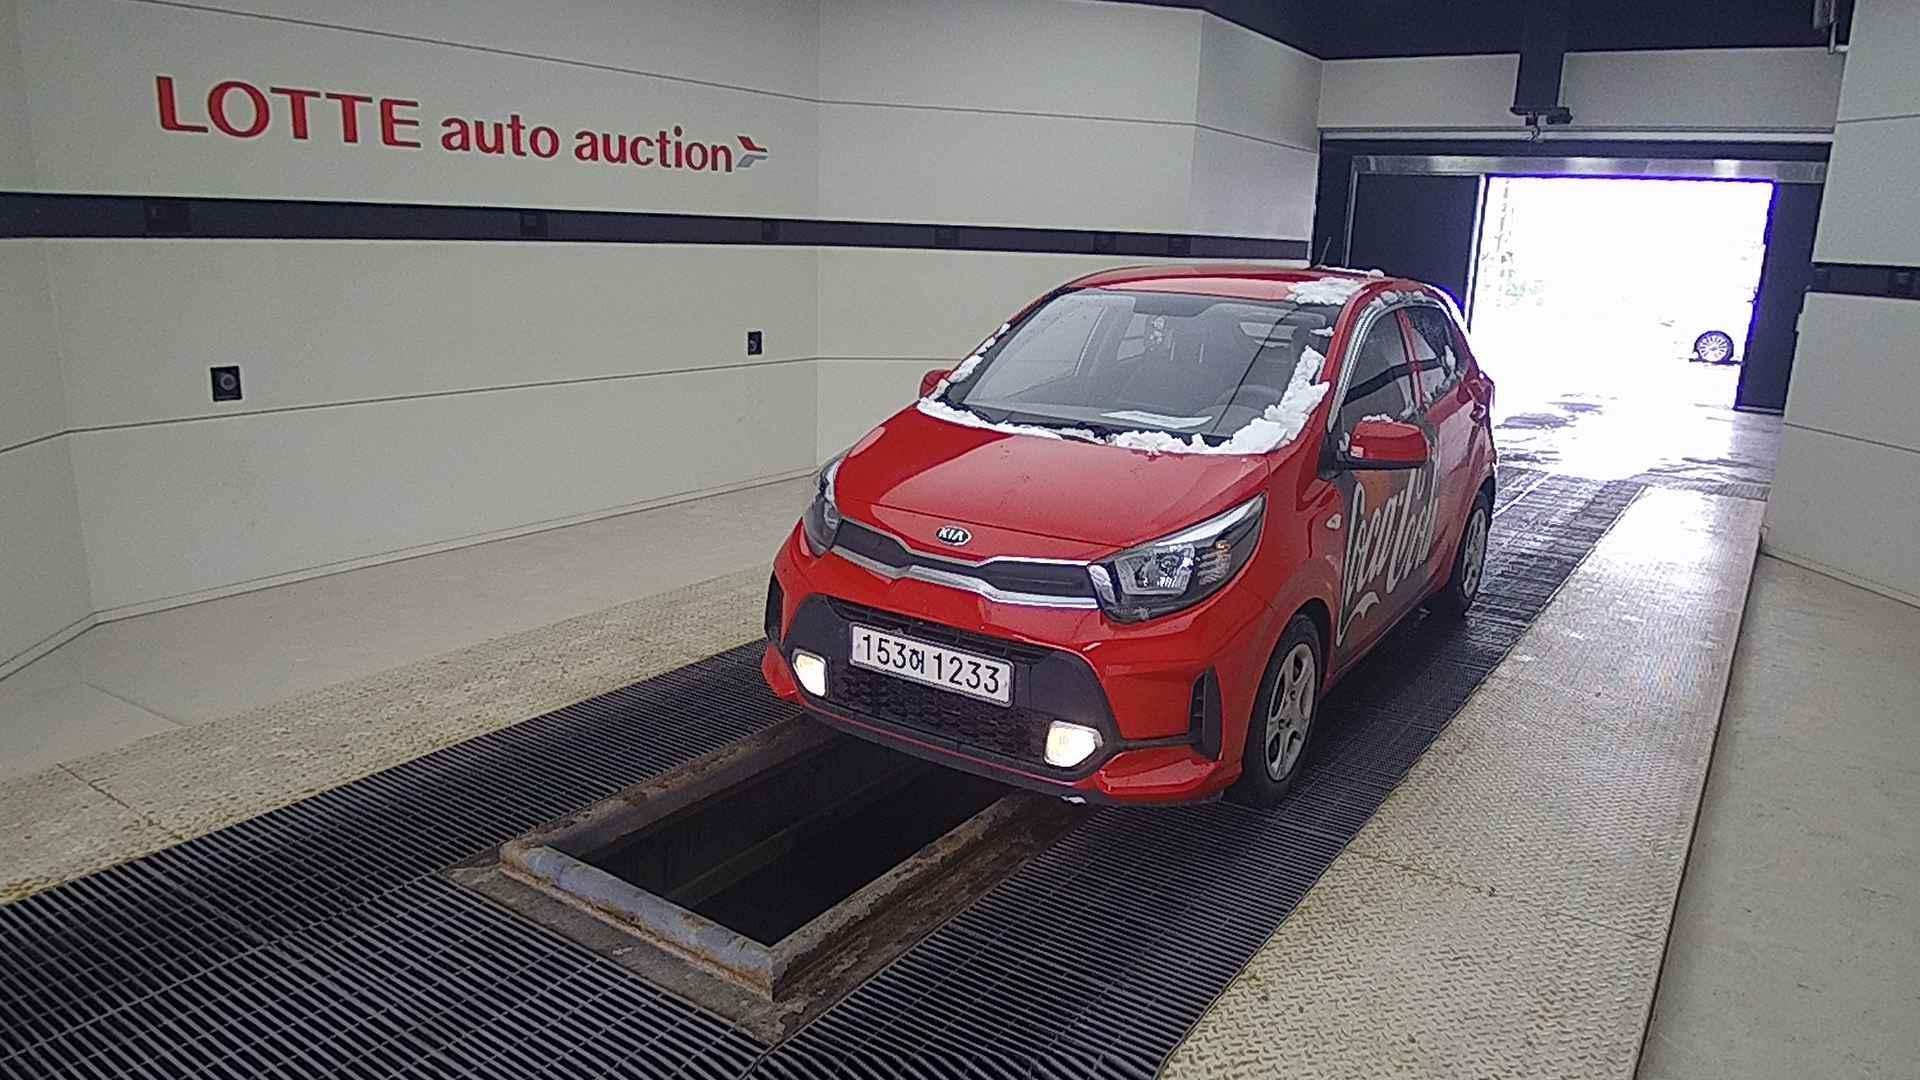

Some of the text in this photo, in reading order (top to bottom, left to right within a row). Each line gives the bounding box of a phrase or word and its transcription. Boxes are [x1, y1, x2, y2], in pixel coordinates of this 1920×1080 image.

[155, 75, 733, 173] LOTTE auto auction
